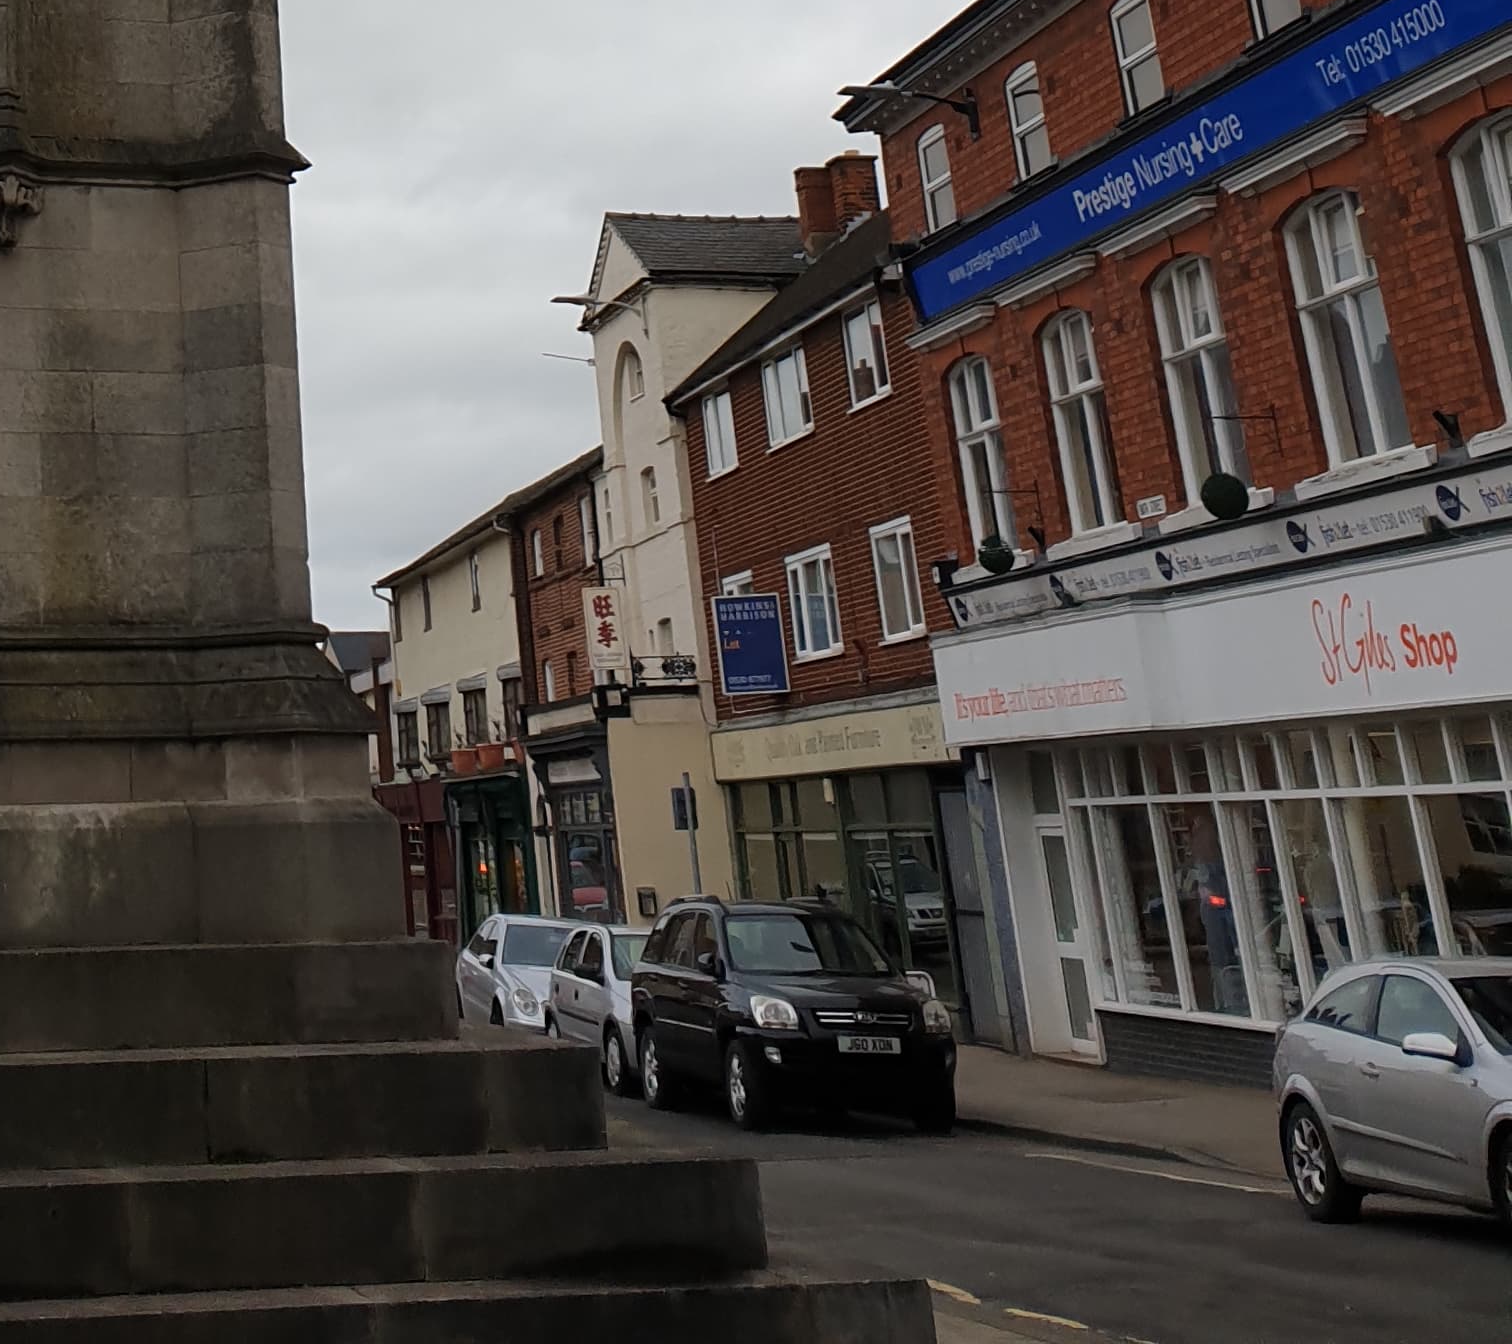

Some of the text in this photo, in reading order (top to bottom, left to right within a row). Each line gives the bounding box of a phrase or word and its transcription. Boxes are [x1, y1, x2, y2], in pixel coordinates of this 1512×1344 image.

[1315, 0, 1445, 86] Tel: 01530 415000
[1073, 113, 1243, 222] Prestige Nursing Care
[1312, 593, 1458, 696] St Giles Shop
